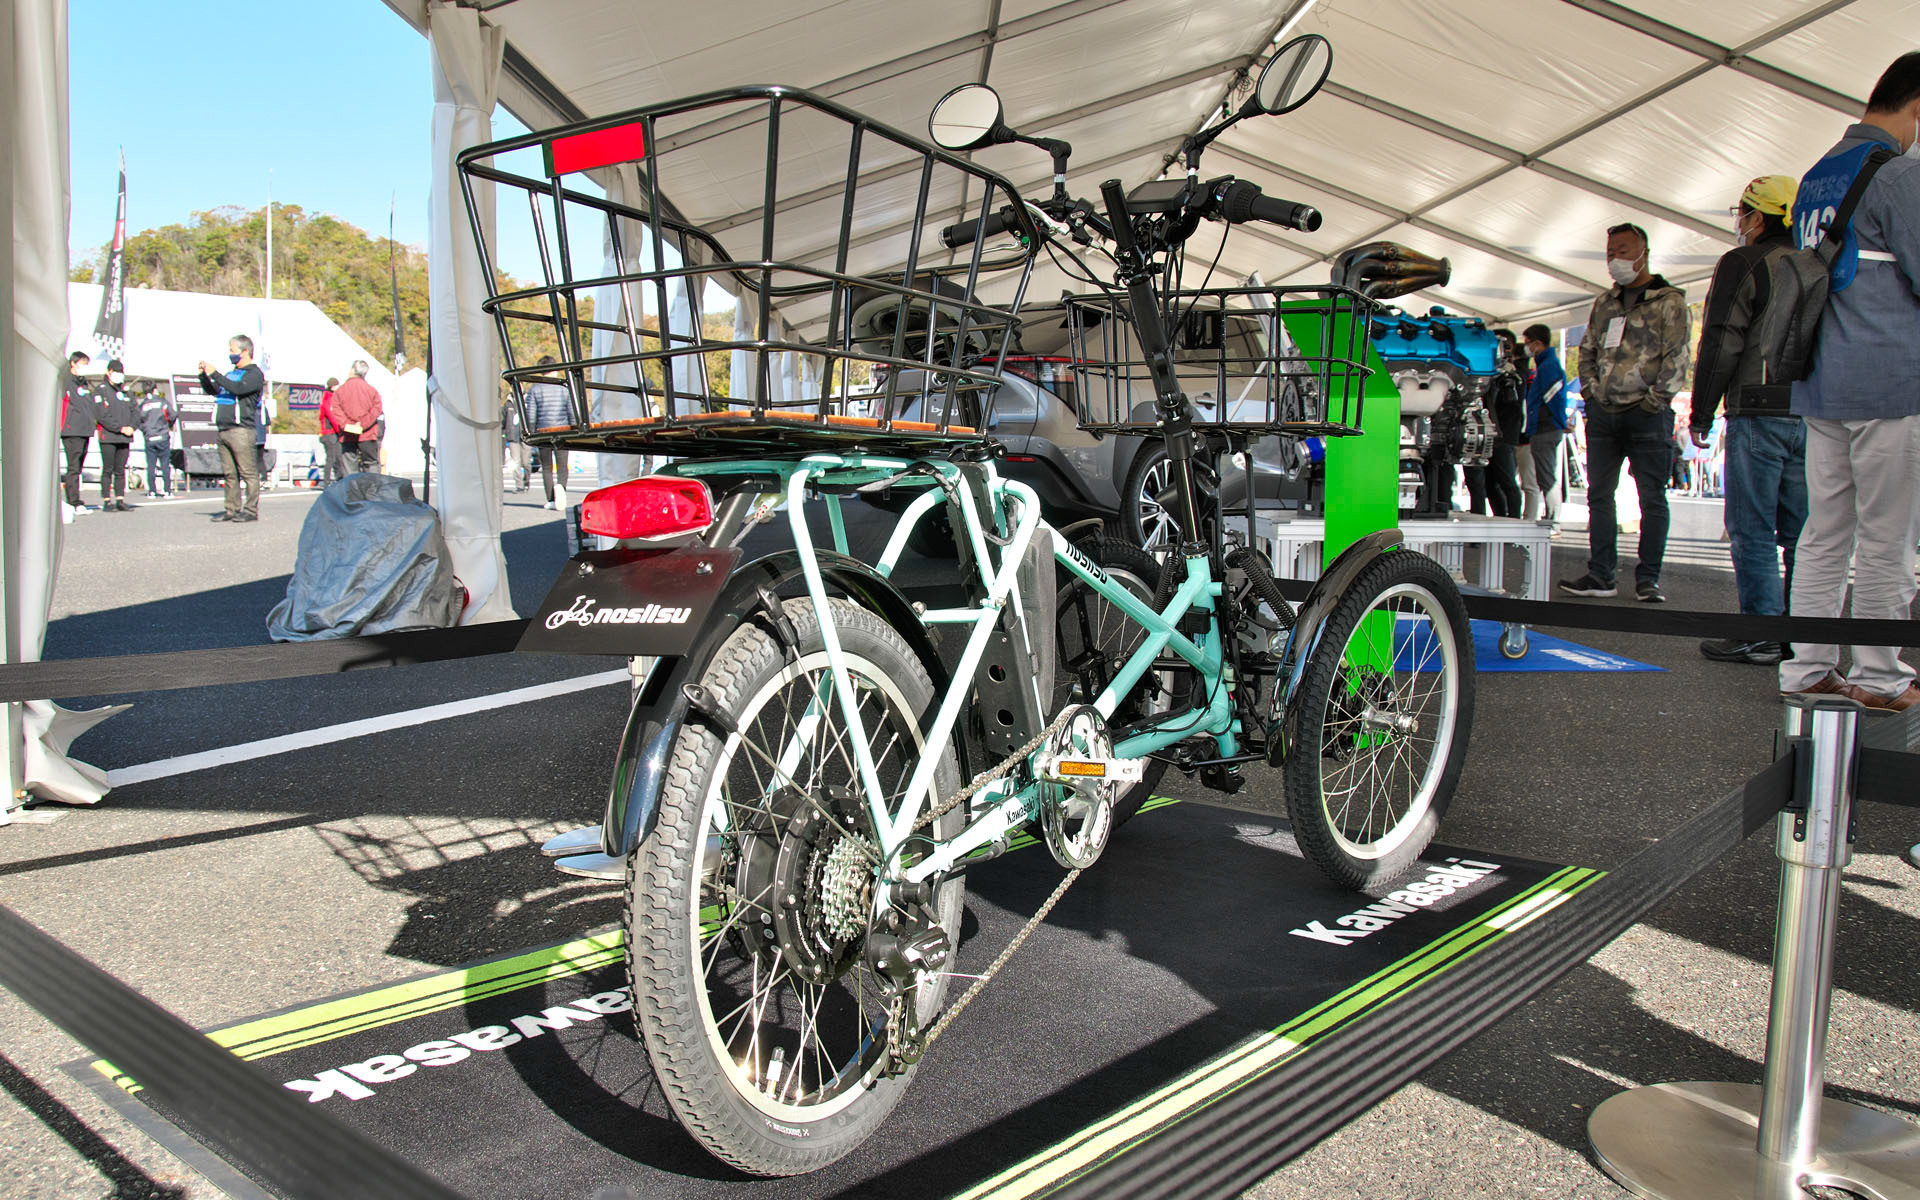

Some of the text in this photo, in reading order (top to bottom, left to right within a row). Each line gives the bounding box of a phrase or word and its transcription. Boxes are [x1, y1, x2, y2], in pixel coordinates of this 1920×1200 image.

[593, 603, 692, 624] noslisu
[1005, 796, 1035, 825] Kawasaki
[1288, 857, 1503, 947] Kawasaki
[283, 986, 634, 1104] awasak
